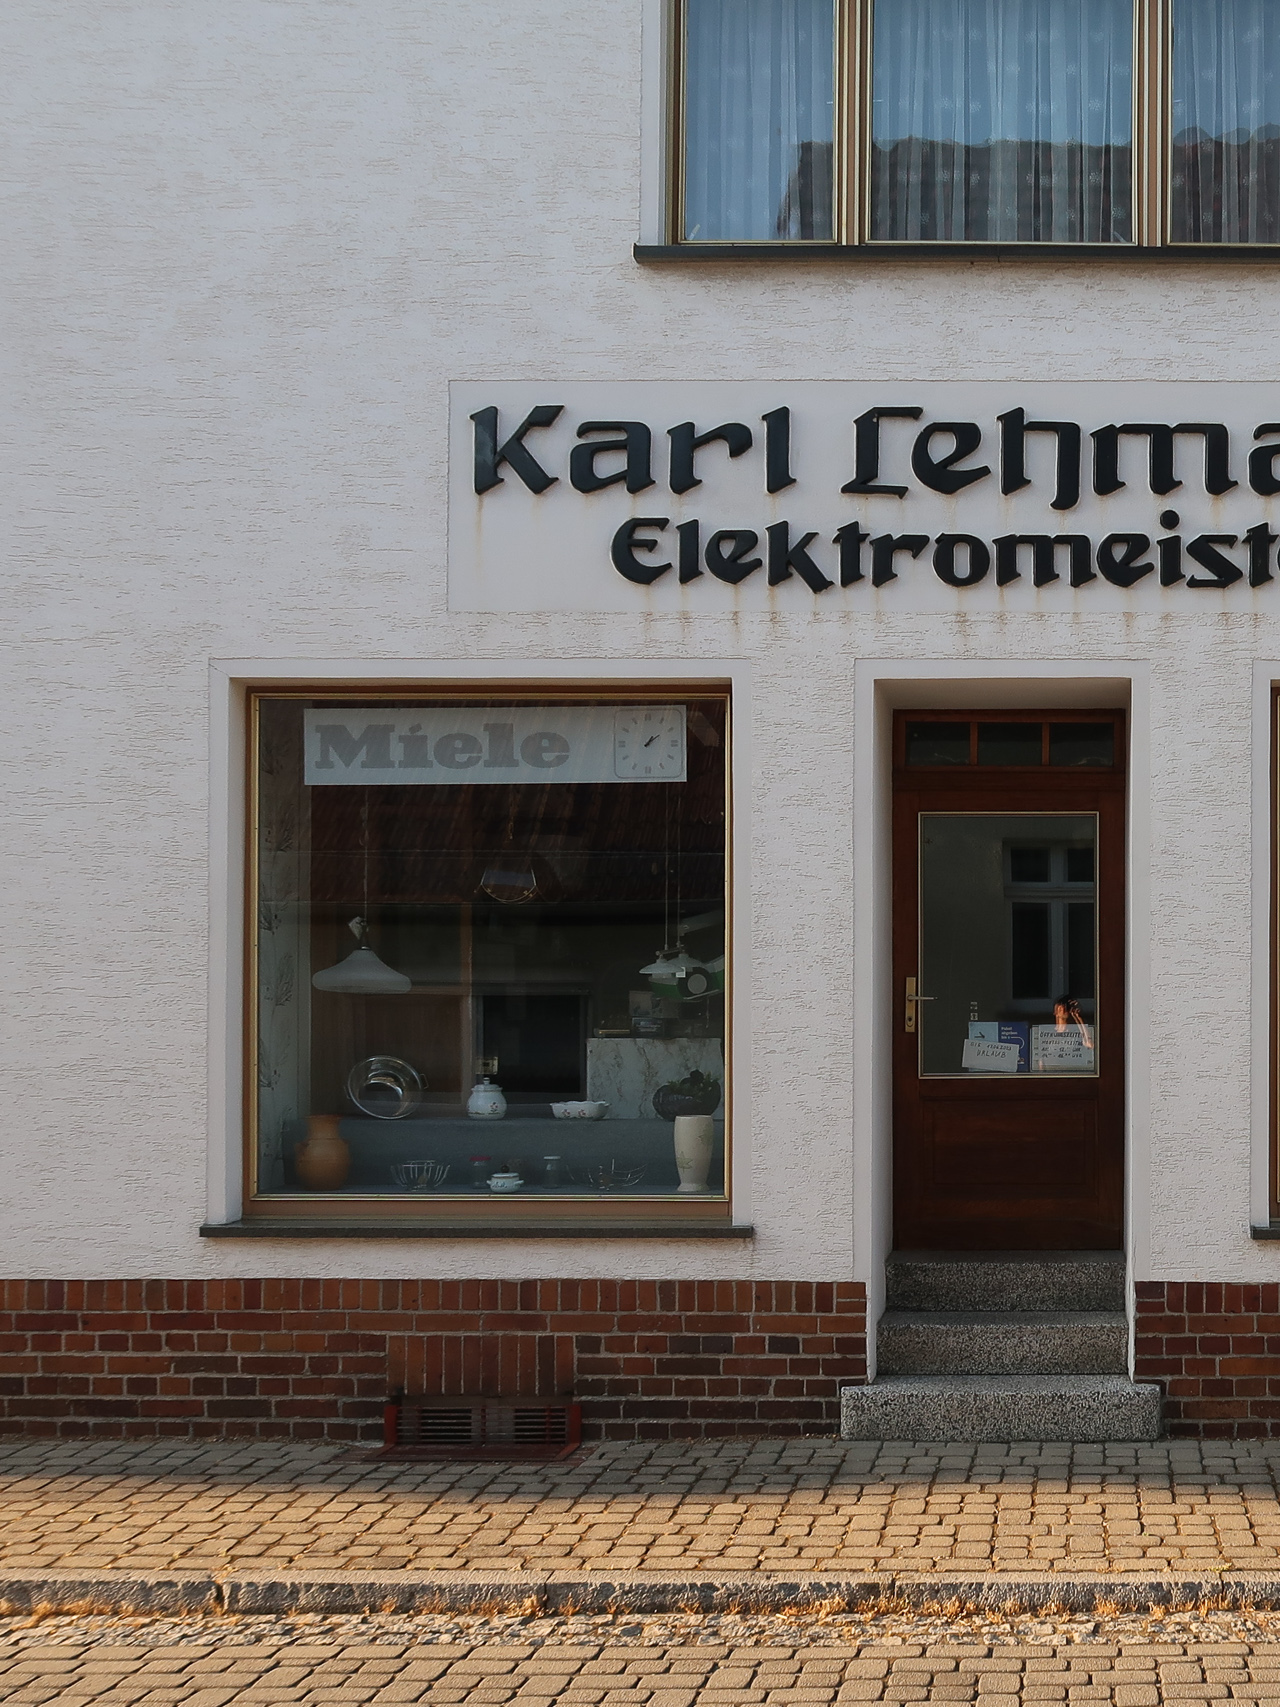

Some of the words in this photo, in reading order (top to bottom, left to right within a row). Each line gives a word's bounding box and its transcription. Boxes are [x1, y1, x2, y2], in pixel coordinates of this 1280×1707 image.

[470, 405, 796, 496] Karl
[315, 723, 570, 769] Miele
[977, 1049, 1006, 1058] URLAUB
